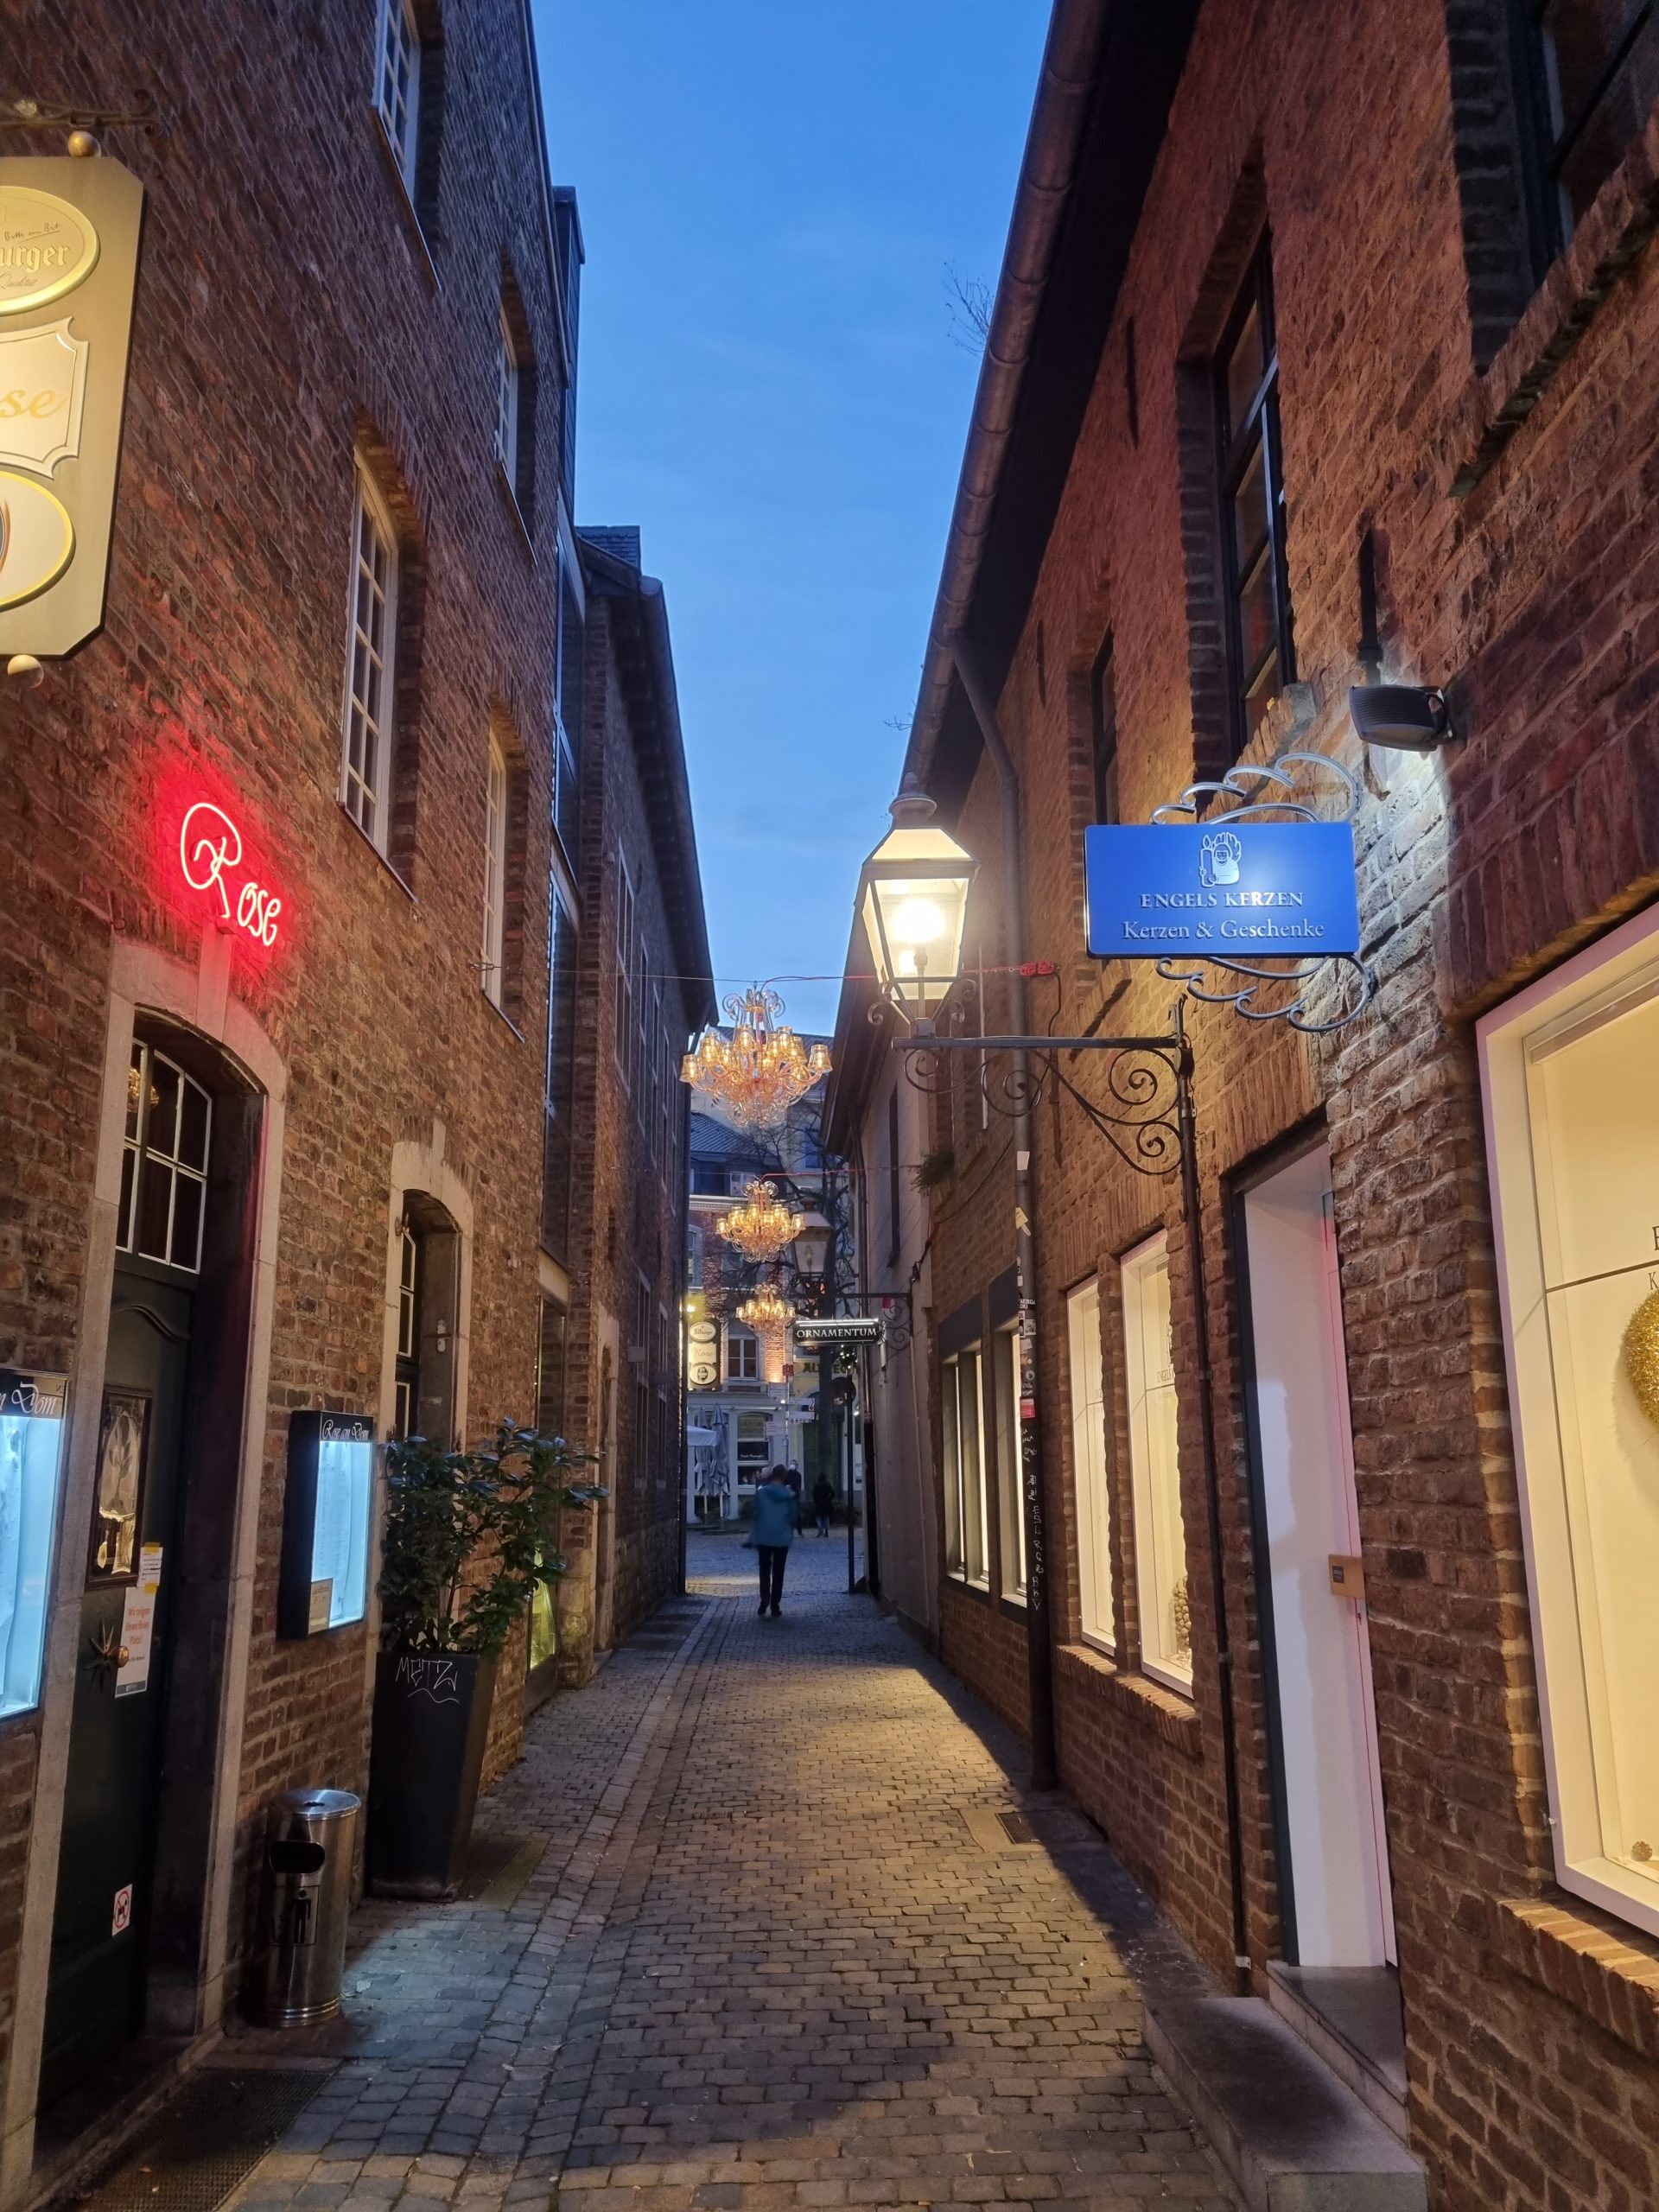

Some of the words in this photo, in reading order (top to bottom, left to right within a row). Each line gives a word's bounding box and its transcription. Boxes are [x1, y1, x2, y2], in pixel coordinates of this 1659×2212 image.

[0, 245, 71, 273] urger
[180, 802, 282, 947] Rose
[1140, 893, 1217, 908] ENGELS
[1224, 891, 1304, 907] KERZEN
[1122, 921, 1190, 939] Kerzen
[1195, 921, 1214, 939] &
[1219, 918, 1325, 939] Geschenke
[796, 1327, 877, 1338] ORNAMENTUM
[11, 1381, 57, 1414] Dom
[322, 1419, 341, 1440] Rose
[351, 1422, 370, 1441] Dom
